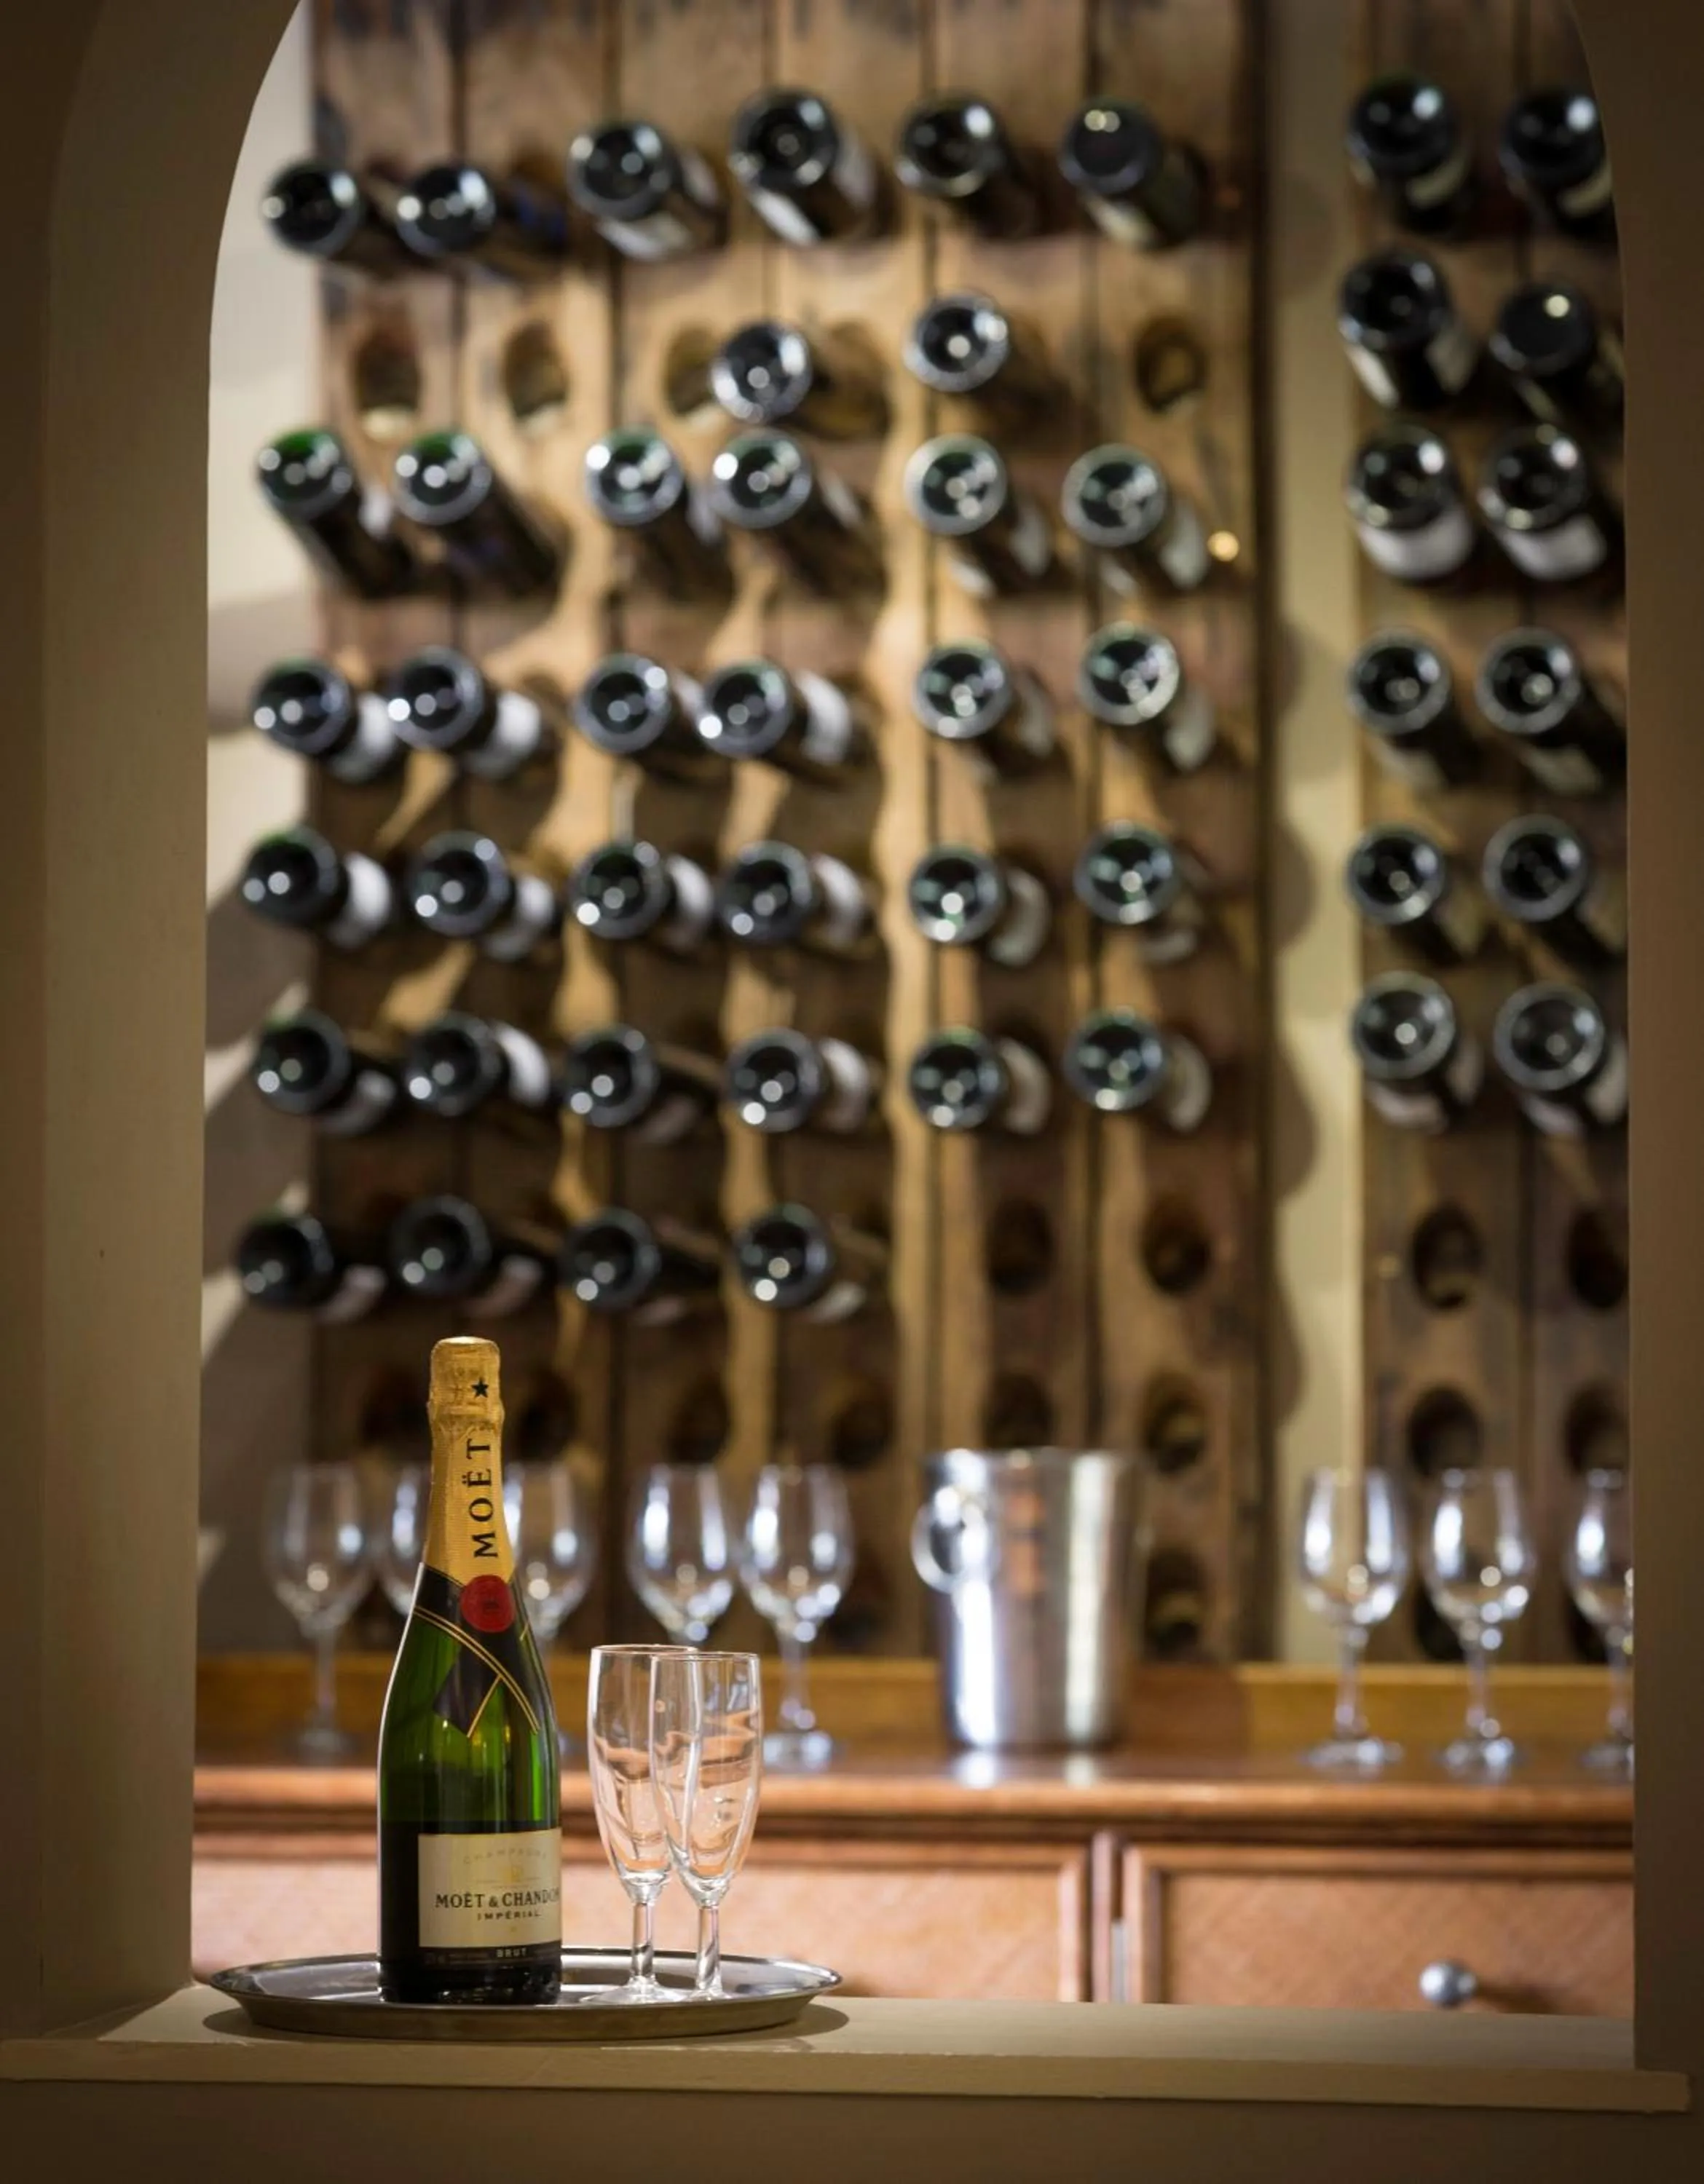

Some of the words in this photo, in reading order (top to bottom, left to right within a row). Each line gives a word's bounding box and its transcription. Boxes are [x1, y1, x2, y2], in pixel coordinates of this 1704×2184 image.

[462, 1438, 498, 1558] MOËT
[489, 1896, 498, 1908] &
[497, 1948, 527, 1958] BRUT
